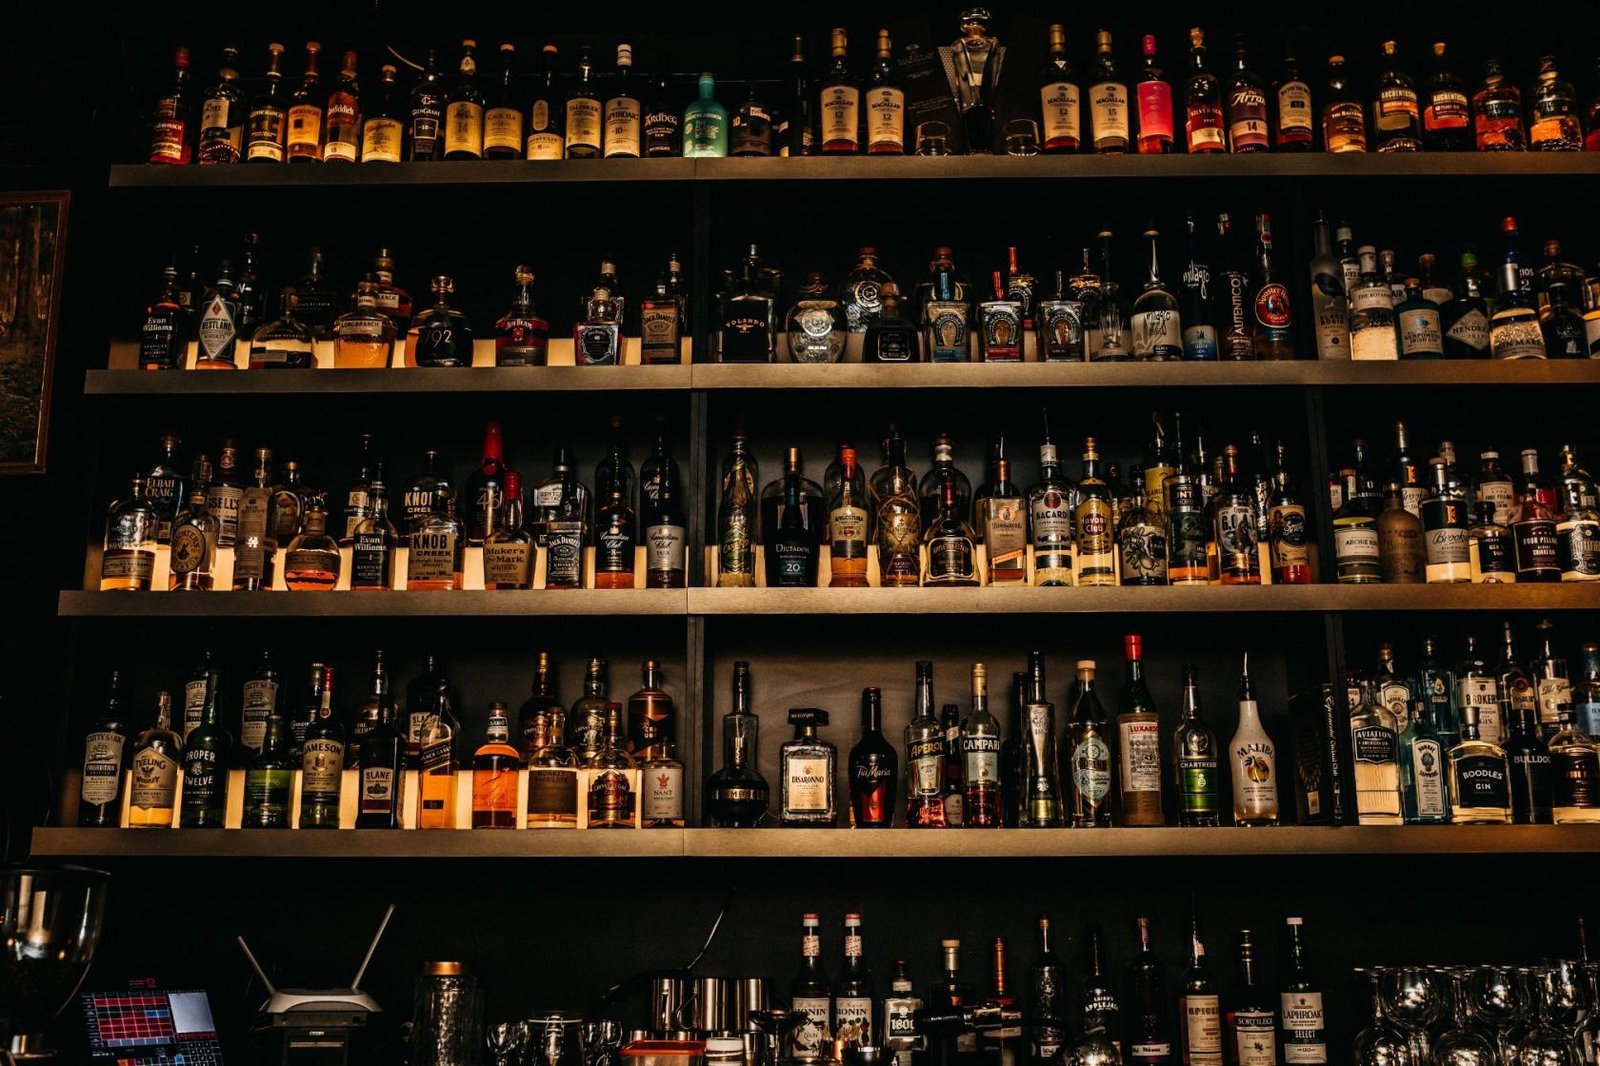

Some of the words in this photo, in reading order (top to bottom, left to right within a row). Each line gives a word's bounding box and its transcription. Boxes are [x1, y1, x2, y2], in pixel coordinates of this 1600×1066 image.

[835, 112, 844, 120] 12
[883, 114, 892, 122] 12
[1059, 109, 1068, 117] 12
[1247, 120, 1258, 133] 14
[1233, 278, 1244, 335] AUTENTICO
[147, 316, 167, 325] Evan
[340, 321, 380, 329] LONGBRANCH
[143, 324, 174, 333] Williams
[202, 321, 233, 331] WESTLAND
[146, 478, 175, 488] ELIJAH
[145, 488, 173, 498] CRAIG
[208, 497, 240, 510] SSELL'S
[1086, 524, 1102, 534] Club
[359, 536, 380, 545] Evan
[413, 534, 448, 550] KNOB
[1345, 539, 1367, 547] ARCHIE
[354, 544, 387, 553] Williams
[485, 548, 526, 557] Maker's
[775, 545, 811, 555] DICTADOR
[498, 556, 525, 566] Mark
[786, 563, 801, 572] 20
[87, 733, 106, 744] CUTTY
[1356, 730, 1393, 741] AVIATION
[304, 742, 342, 754] JAMESON
[910, 740, 945, 758] APEROL
[963, 739, 1000, 751] CAMPARI
[1237, 741, 1274, 757] MALIBU
[185, 748, 217, 762] PROPER
[135, 756, 166, 769] TEELING
[185, 775, 215, 786] TWELVE
[365, 771, 391, 781] SLANE
[791, 775, 825, 785] DISARONNO
[1463, 769, 1503, 783] BOODLES
[1475, 783, 1491, 791] GIN
[1284, 1009, 1323, 1020] LAPHROAIG
[1295, 1031, 1316, 1039] SELECT
